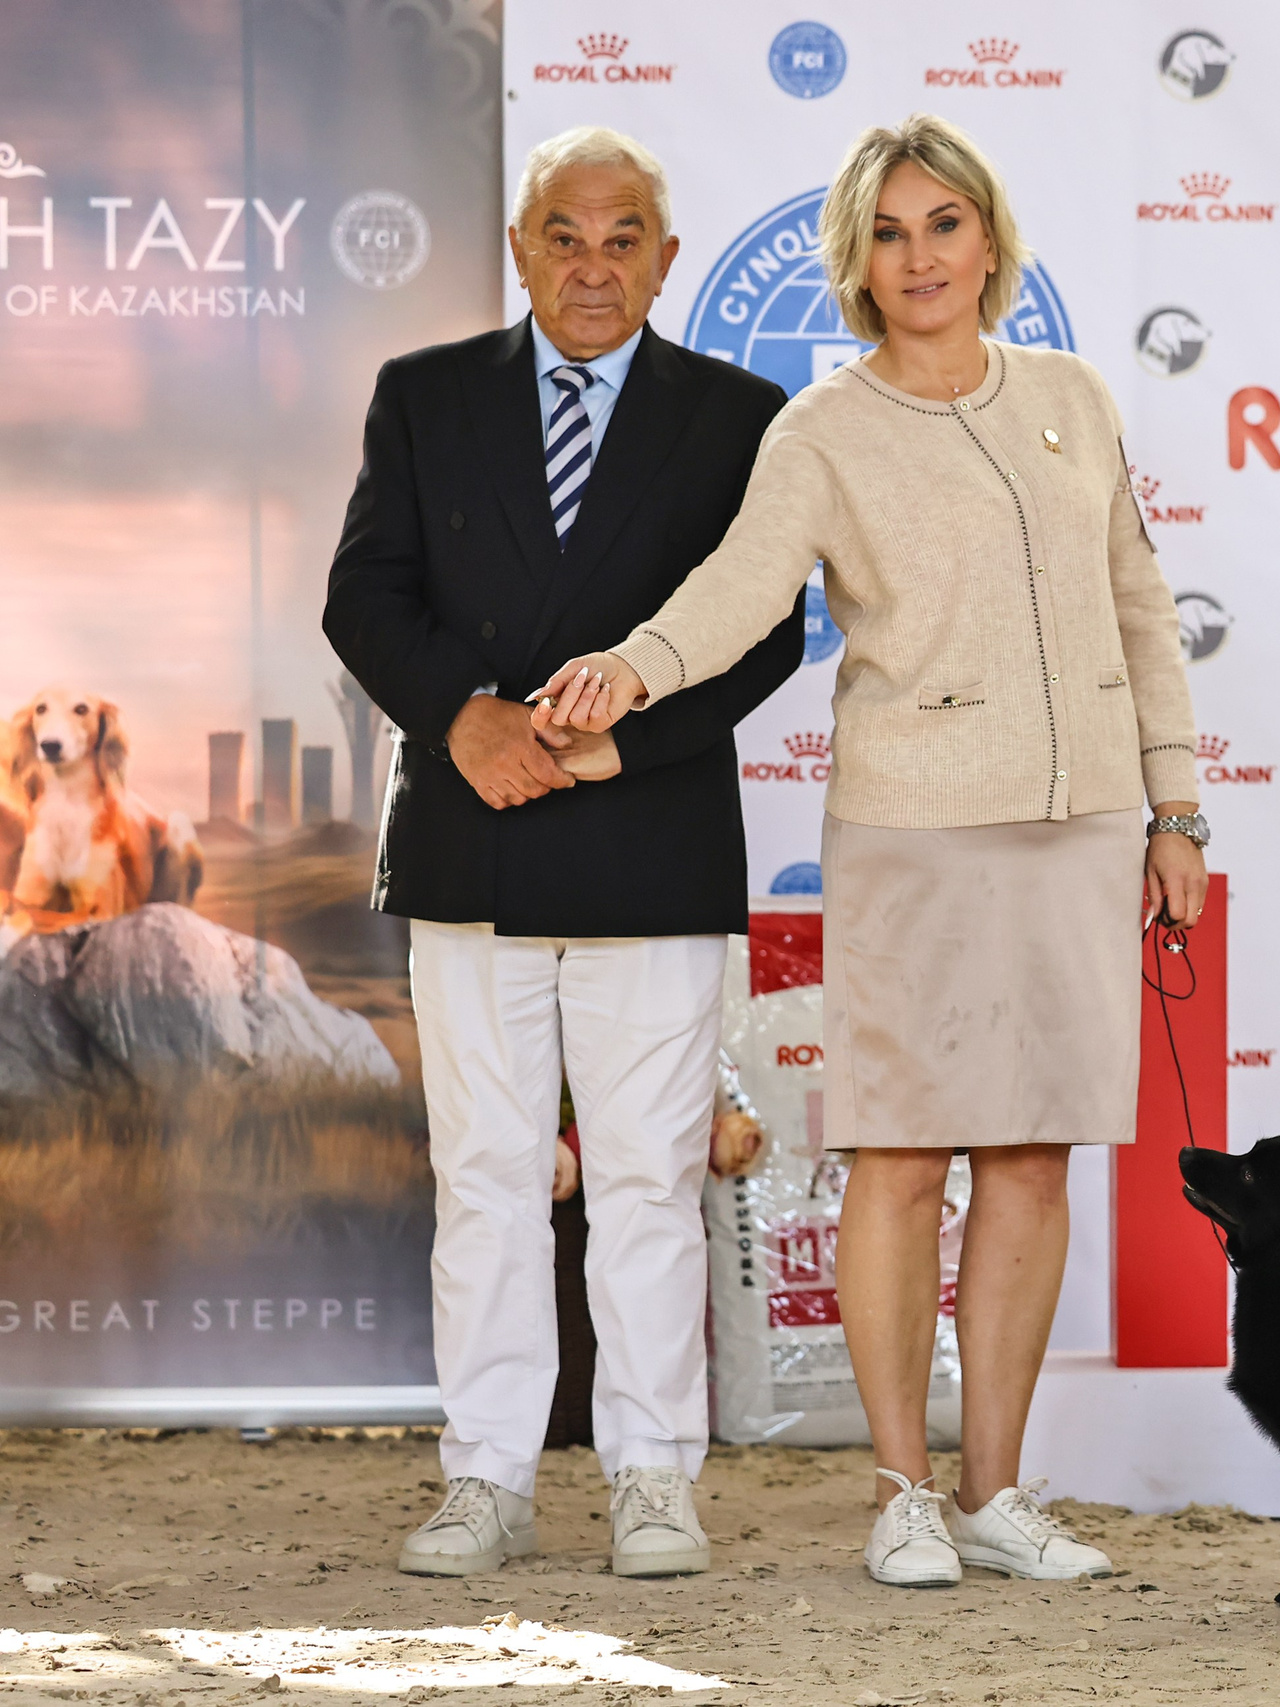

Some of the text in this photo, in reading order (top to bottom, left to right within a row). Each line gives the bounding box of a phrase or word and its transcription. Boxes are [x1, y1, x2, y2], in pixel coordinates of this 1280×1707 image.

[793, 51, 824, 69] FCI
[533, 65, 674, 83] ROYAL CANIN
[925, 69, 1064, 88] ROYAL CANIN
[1137, 204, 1274, 222] ROYAL CANIN
[89, 197, 306, 272] TAZY
[358, 228, 400, 250] FCI
[5, 284, 305, 318] OF KAZAKHSTAN
[1145, 507, 1203, 522] ANIN
[804, 616, 822, 633] CI
[742, 763, 804, 781] ROYAL
[1205, 767, 1273, 784] CANIN
[0, 1299, 377, 1332] GREAT STEPPE
